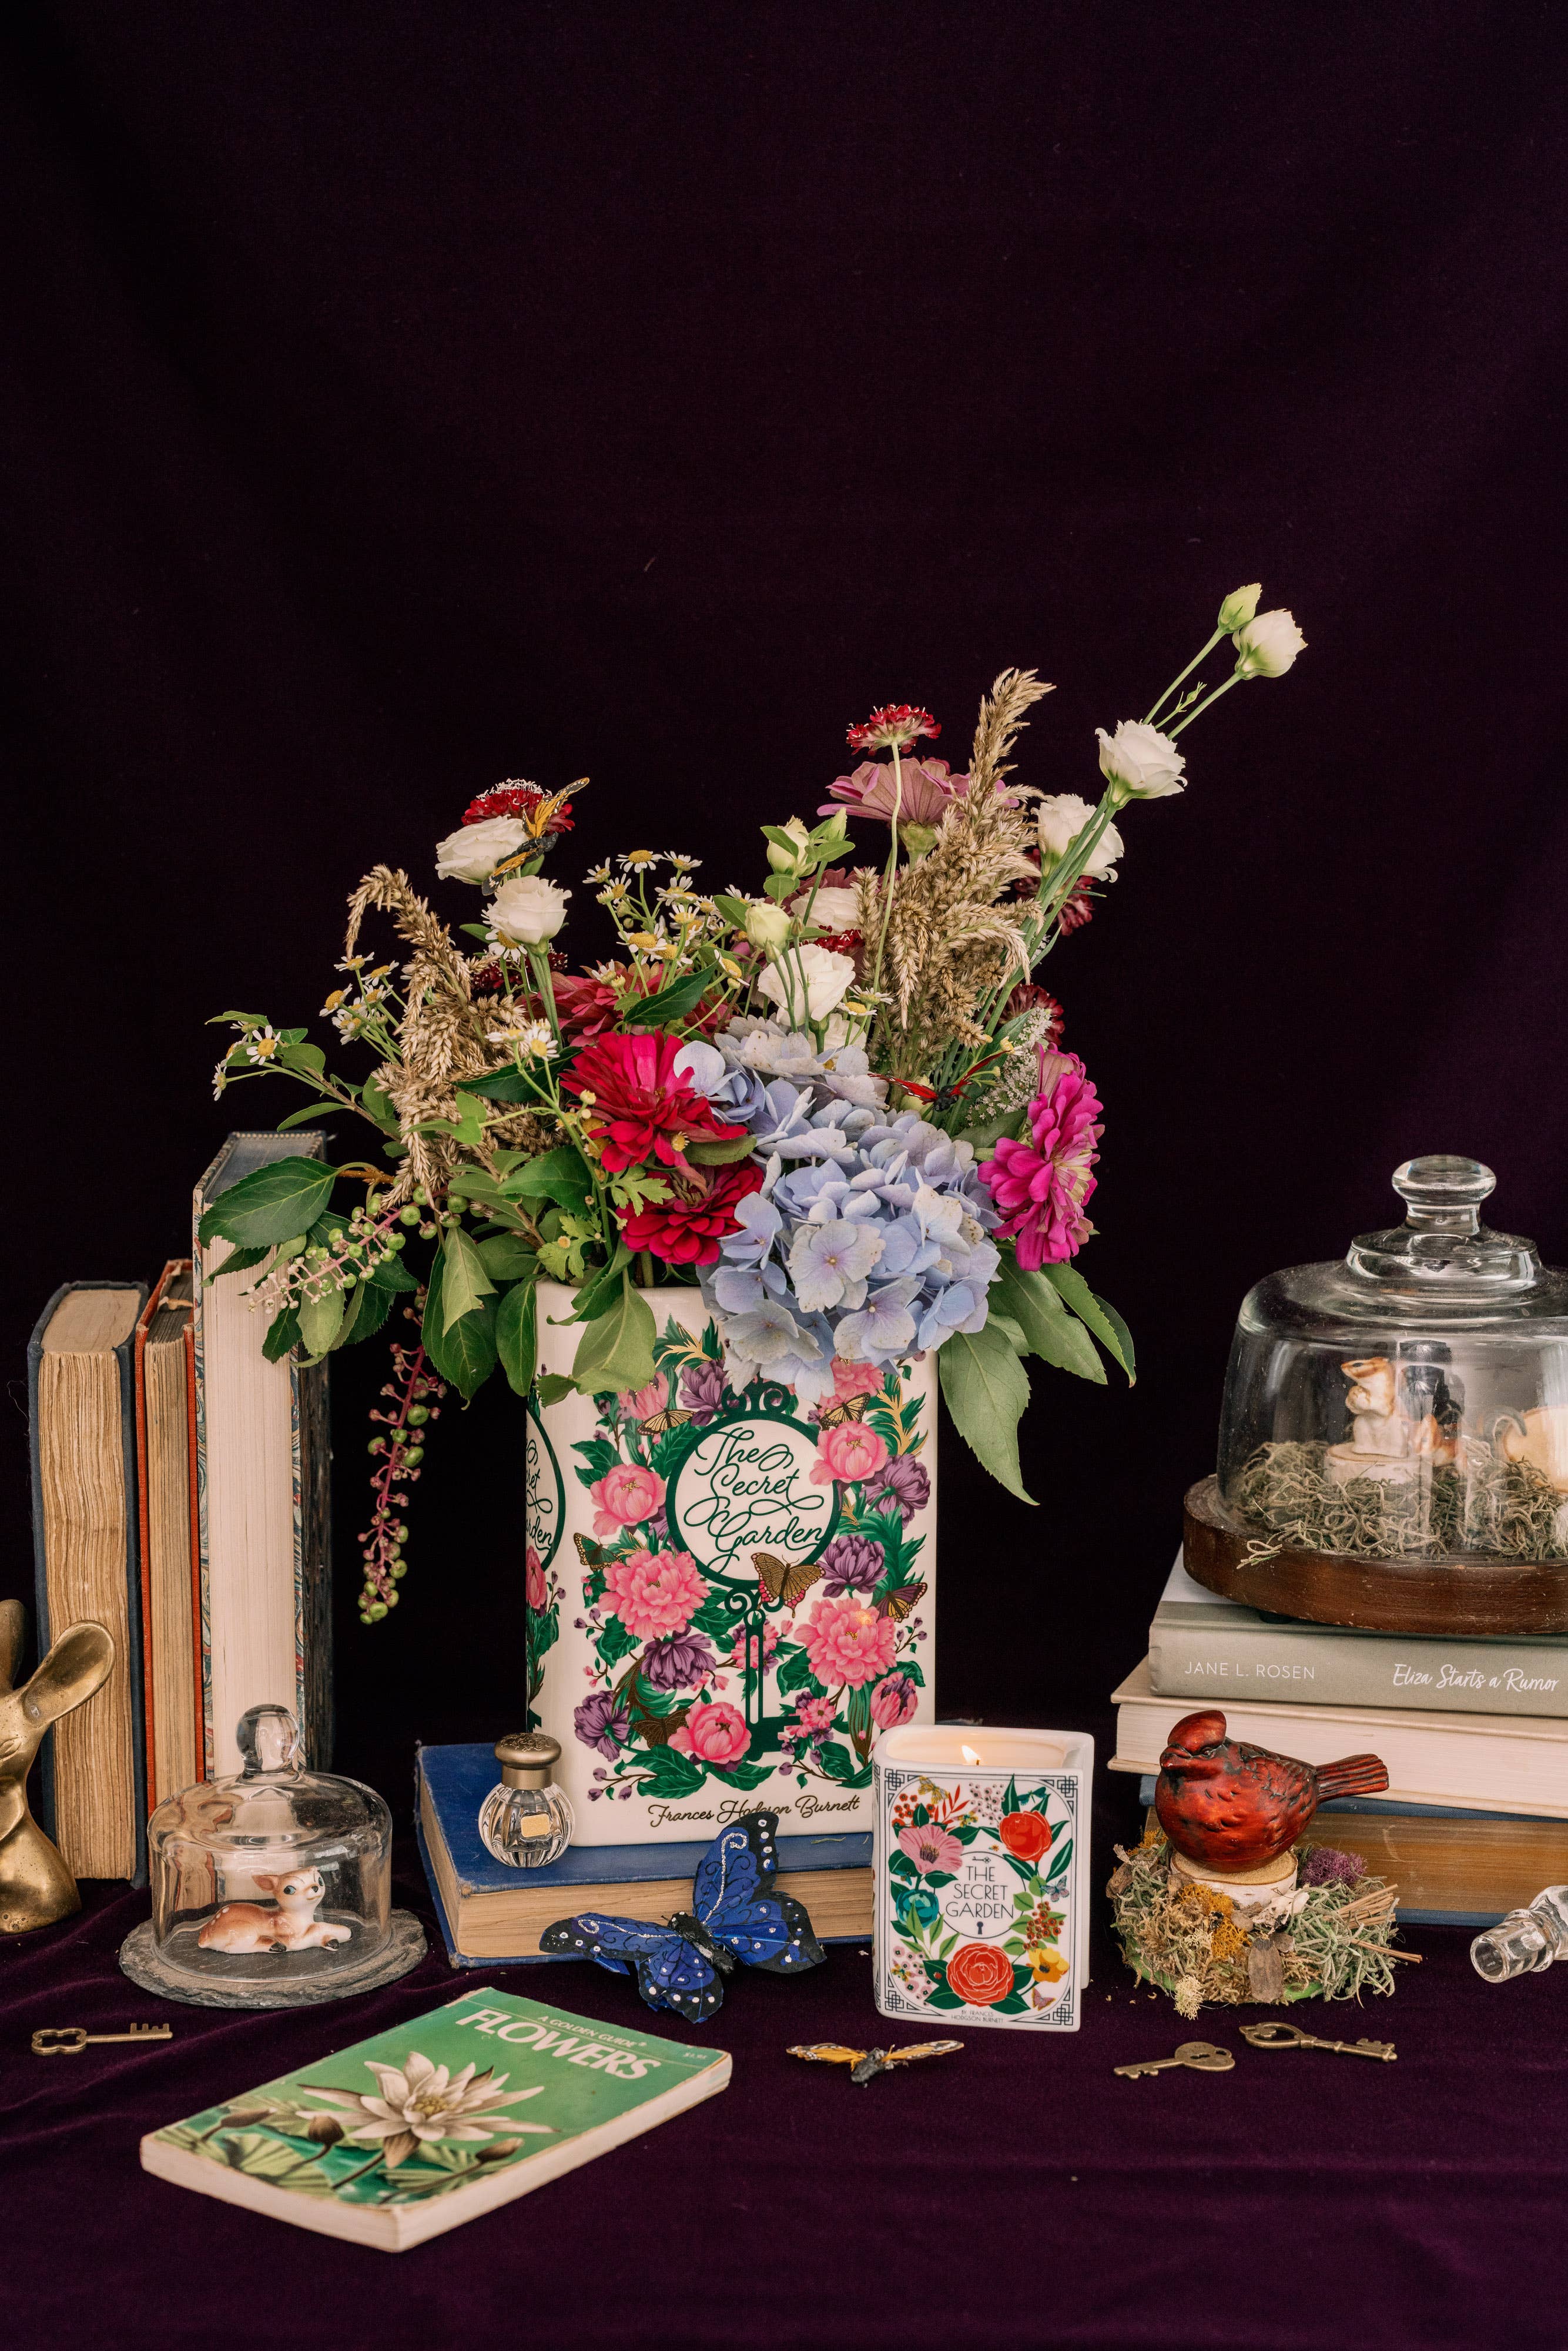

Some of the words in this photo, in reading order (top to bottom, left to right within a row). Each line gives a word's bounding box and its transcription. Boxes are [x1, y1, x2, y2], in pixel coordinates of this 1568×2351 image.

[694, 1427, 794, 1476] The
[706, 1511, 822, 1573] Garden
[1184, 1662, 1228, 1676] JANE
[1236, 1663, 1249, 1676] L.
[1257, 1664, 1315, 1679] ROSEN
[1393, 1663, 1433, 1686] Eliza
[1436, 1664, 1486, 1689] Starts
[1489, 1676, 1502, 1688] a
[1503, 1668, 1559, 1692] Rumor
[648, 1804, 714, 1827] Frances
[717, 1799, 792, 1824] Hodson
[795, 1794, 860, 1818] Burnett
[966, 1866, 996, 1882] THE
[953, 1883, 1008, 1900] SECRET
[946, 1901, 1013, 1919] GARDEN
[951, 2014, 981, 2022] HODGSON
[550, 2019, 598, 2037] GOLDEN
[455, 2009, 661, 2080] FLOWERS
